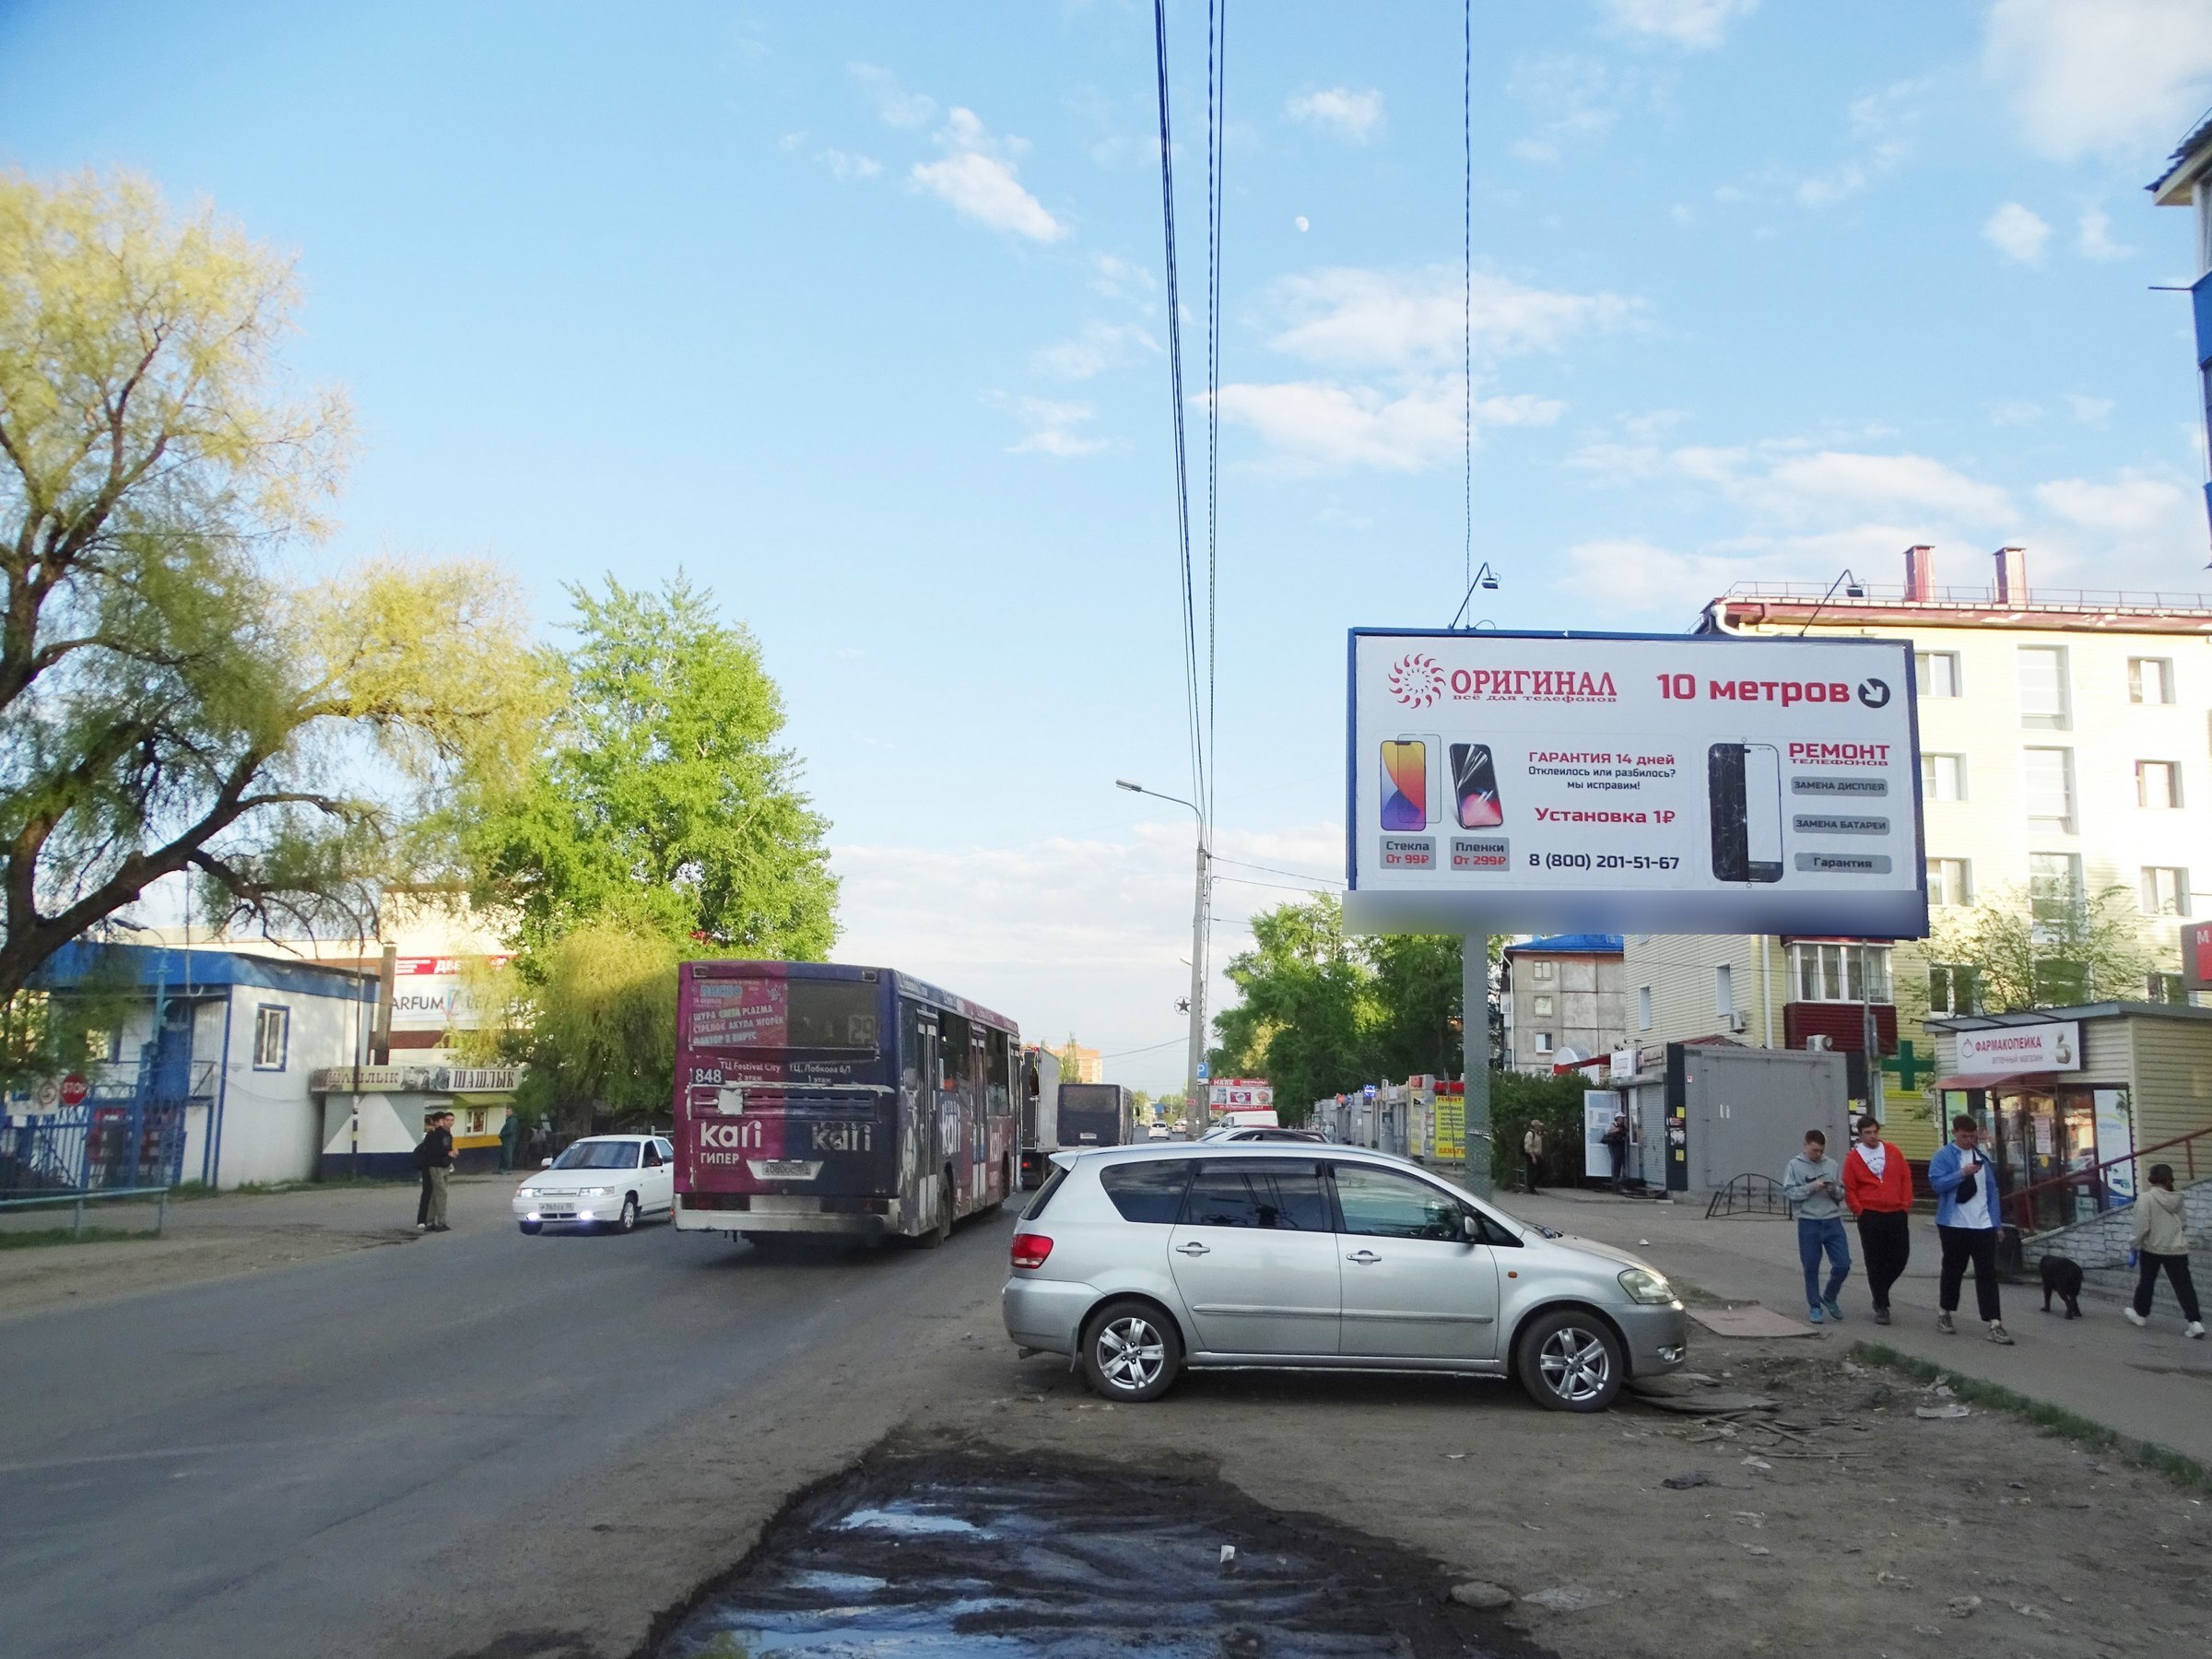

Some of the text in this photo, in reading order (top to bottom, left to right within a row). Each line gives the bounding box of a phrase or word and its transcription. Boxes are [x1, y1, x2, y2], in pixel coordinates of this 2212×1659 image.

[1451, 669, 1618, 696] ОРИГИНАЛ
[1656, 674, 1851, 707] 10 метров
[1789, 742, 1890, 759] РЕМОНТ
[1529, 751, 1675, 766] ГАРАНТИЯ 14 дней
[1790, 758, 1888, 767] ТЕЛЕФОНОВ
[1528, 766, 1676, 778] Отклеилось или разбилось?
[1586, 781, 1641, 791] исправим!
[1794, 781, 1885, 792] ЗАМЕНА ДИСПЛЕЯ
[1535, 807, 1647, 823] Установка
[1796, 819, 1838, 829] ЗАМЕНА
[1386, 841, 1430, 851] Стекла
[1455, 841, 1504, 853] Пленки
[1386, 853, 1401, 864] От
[1453, 855, 1469, 865] От
[1529, 853, 1680, 870] 8 (800) 201-51-67
[1813, 857, 1872, 868] Гарантия
[391, 995, 443, 1010] ARFUM
[1975, 1034, 2042, 1052] ФАРМАКОПЕЙКА
[453, 1071, 514, 1088] ШАШЛЫК
[695, 1068, 722, 1083] 848
[700, 1121, 762, 1148] kari
[700, 1152, 739, 1165] ГИПЕР
